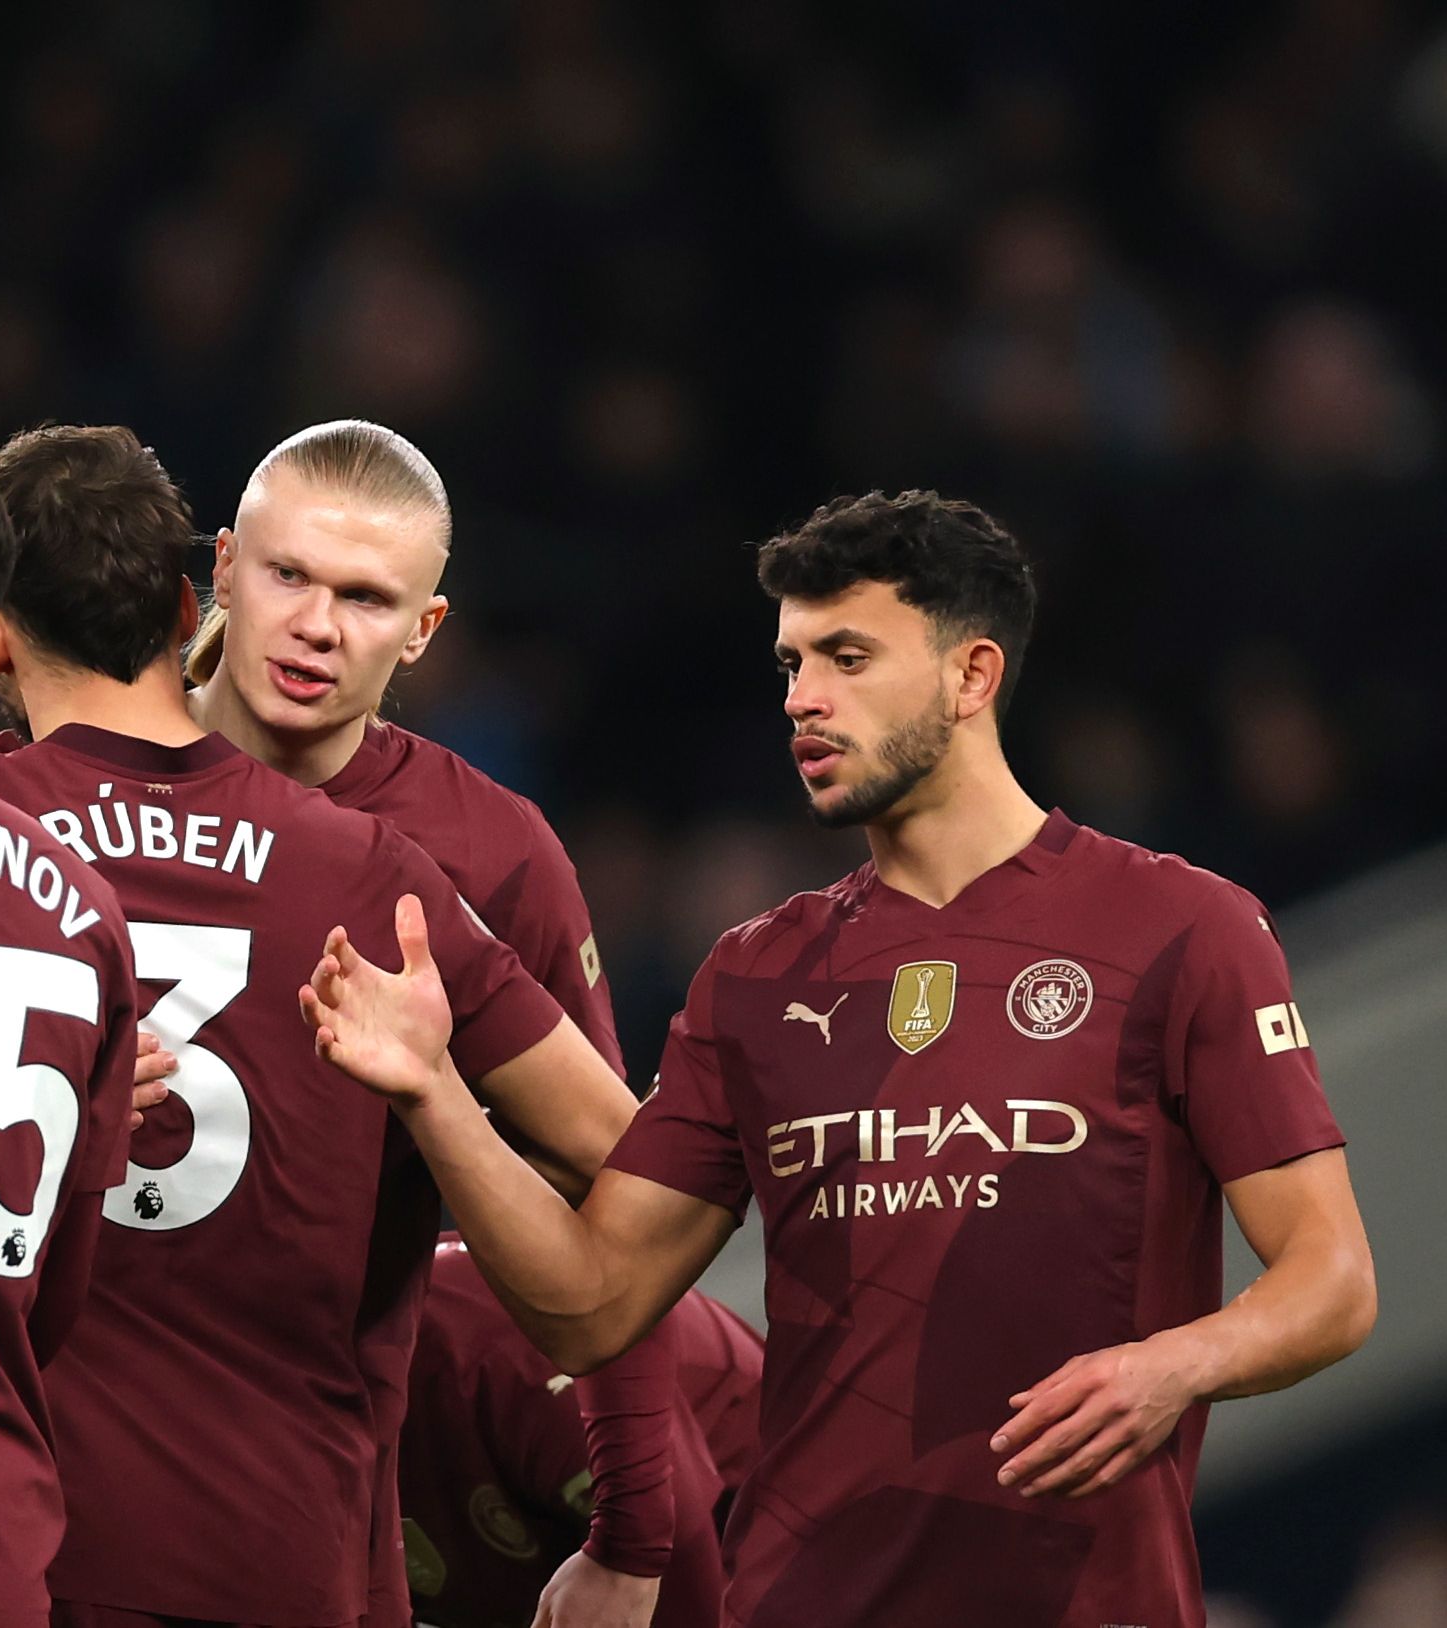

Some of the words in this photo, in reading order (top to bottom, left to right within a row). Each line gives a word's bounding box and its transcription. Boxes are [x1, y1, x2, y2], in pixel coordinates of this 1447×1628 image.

[40, 783, 274, 883] RÚBEN
[1019, 965, 1085, 989] MANCHESTER
[904, 1019, 932, 1031] FIFA
[1032, 1024, 1058, 1032] CITY
[102, 922, 251, 1231] 3
[766, 1099, 1088, 1178] ETIHAD
[809, 1174, 999, 1220] AIRWAYS
